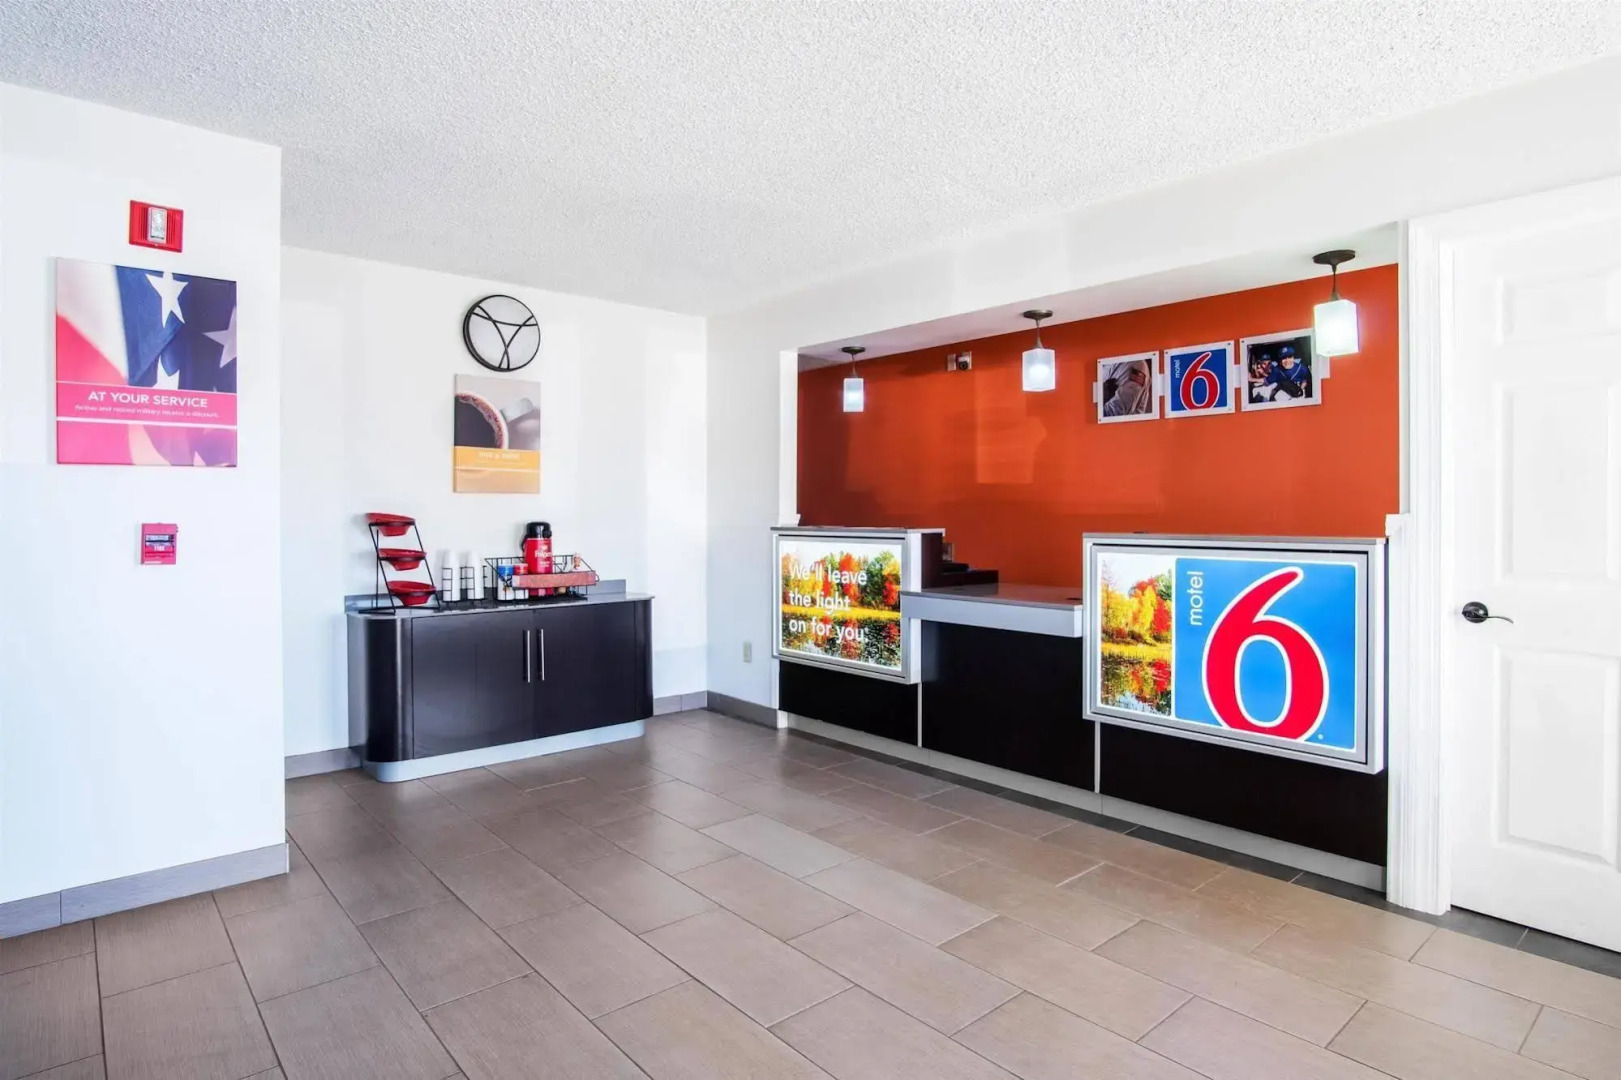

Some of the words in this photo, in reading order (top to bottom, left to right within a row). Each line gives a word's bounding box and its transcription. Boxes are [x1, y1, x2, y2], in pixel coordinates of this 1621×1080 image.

[1180, 351, 1220, 411] 6
[87, 390, 107, 402] AT
[110, 391, 149, 404] YOUR
[153, 394, 208, 408] SERVICE
[788, 562, 823, 582] We'll
[828, 563, 868, 586] leave
[788, 588, 812, 608] the
[815, 589, 851, 615] light
[788, 618, 806, 633] on
[811, 616, 832, 637] for
[1187, 570, 1204, 626] motel
[1202, 566, 1330, 742] 6
